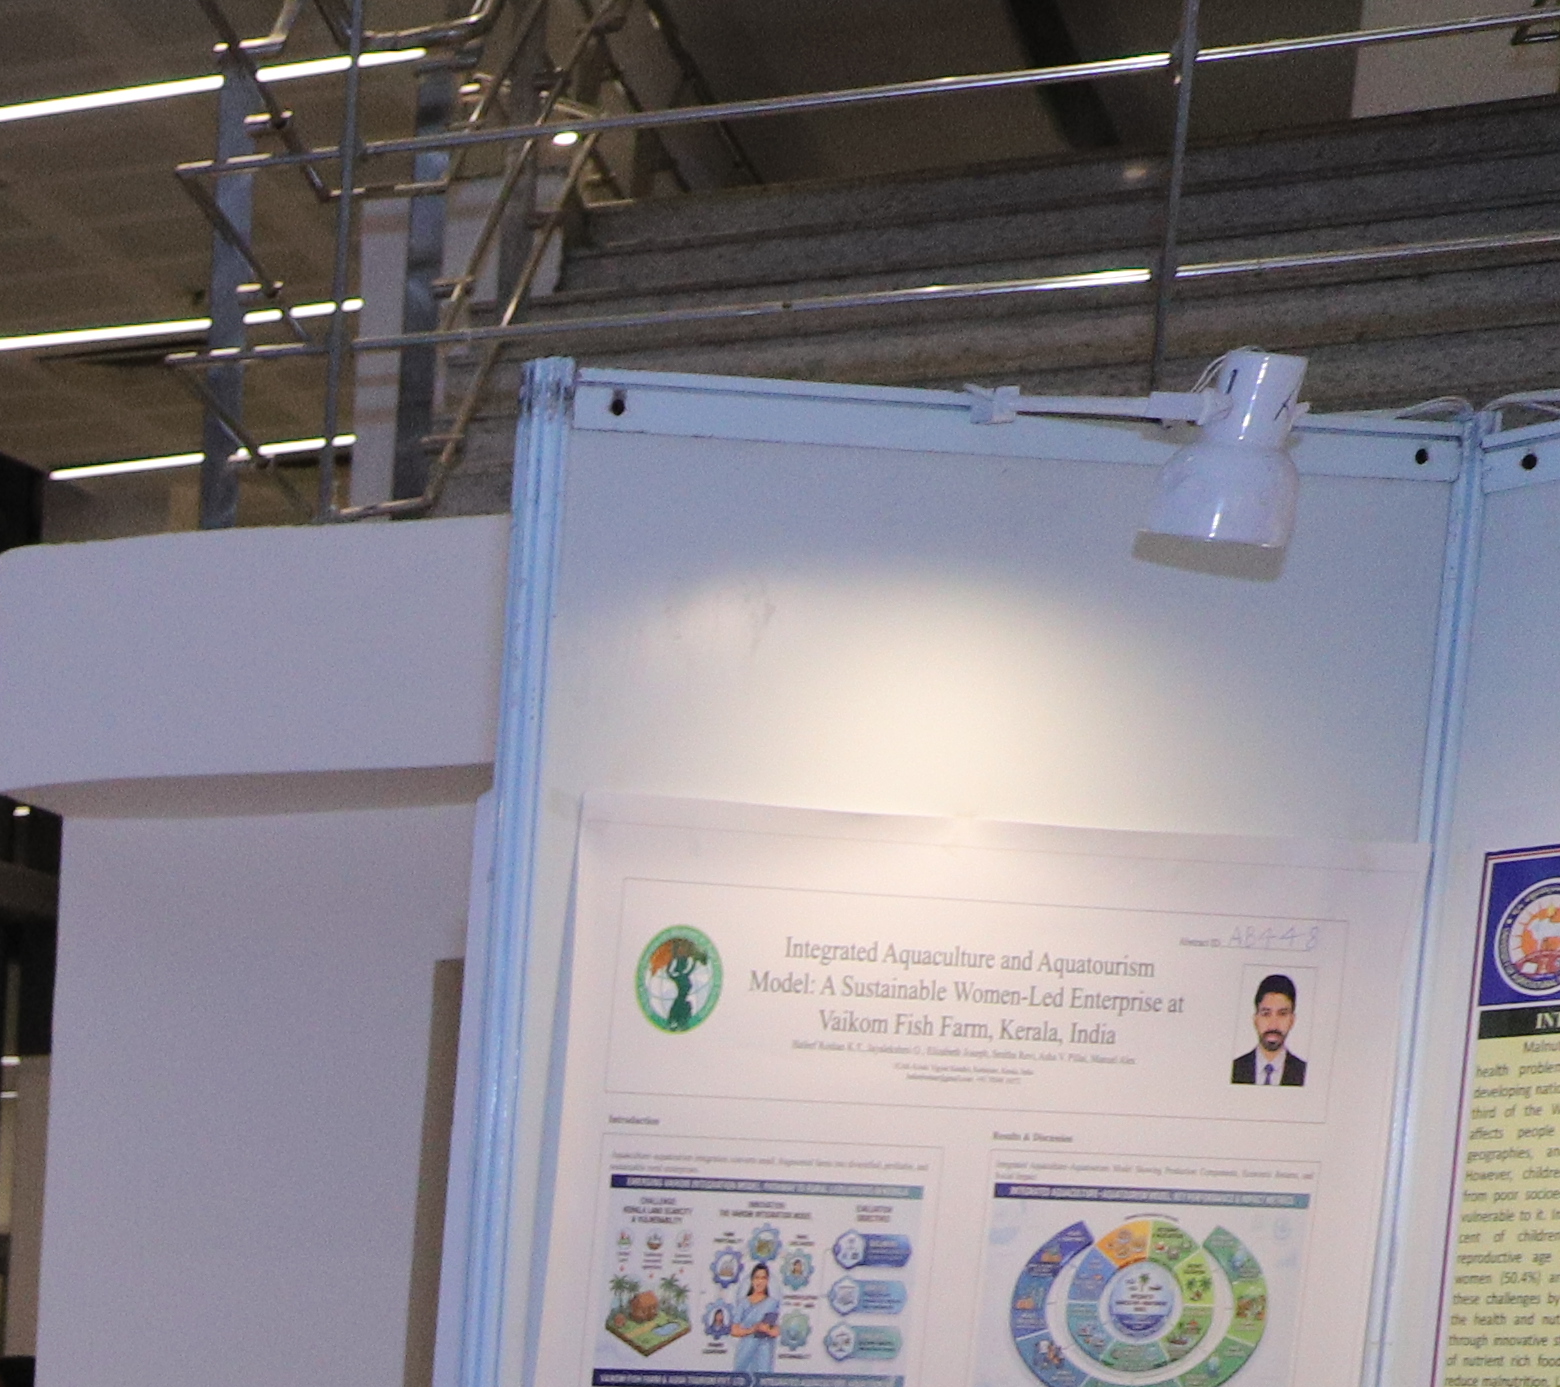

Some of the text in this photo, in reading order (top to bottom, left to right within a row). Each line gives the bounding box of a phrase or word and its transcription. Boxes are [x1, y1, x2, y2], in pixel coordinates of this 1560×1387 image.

[784, 935, 1156, 980] Integrated Aquaculture and Aquatourism
[748, 969, 1186, 1017] Model: A Sustainable Women-Led Enterprise at
[818, 1009, 1117, 1046] Vaikom Fish Farm, Kerala, India
